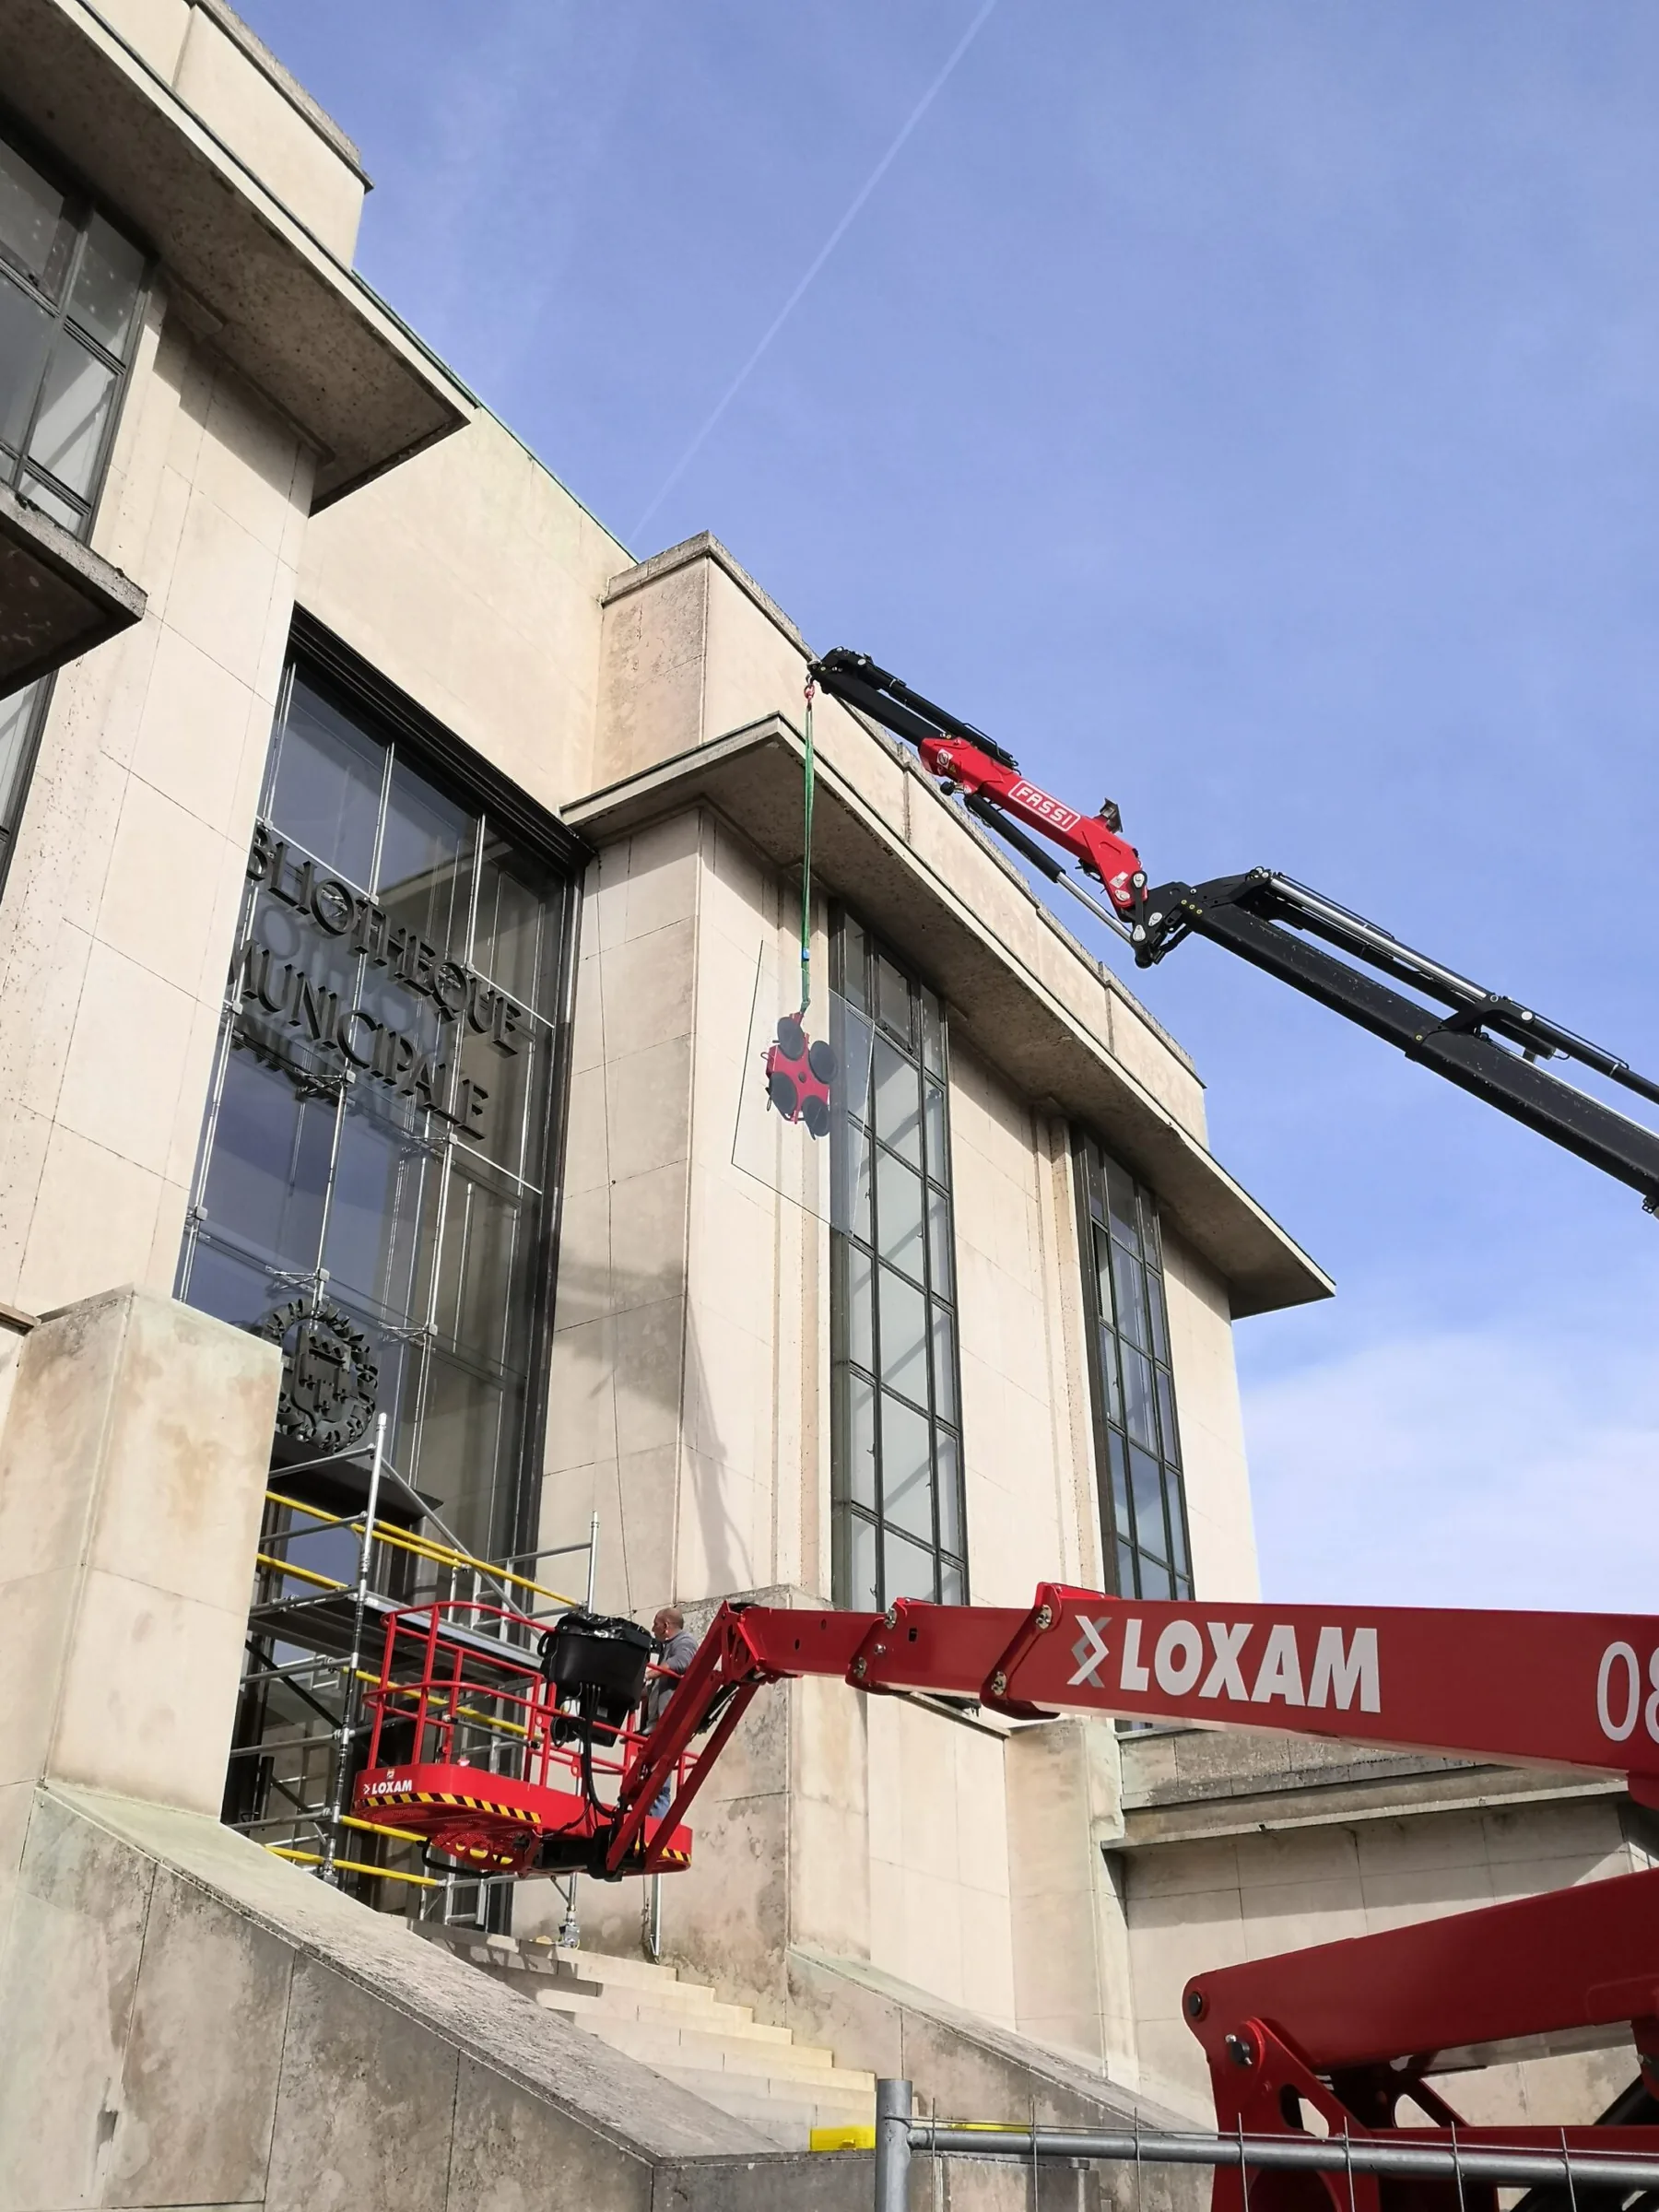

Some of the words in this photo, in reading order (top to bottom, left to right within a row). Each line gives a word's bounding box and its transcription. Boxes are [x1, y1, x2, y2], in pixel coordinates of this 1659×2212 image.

[1016, 786, 1072, 826] FASSI
[1120, 1618, 1381, 1713] LOXAM
[371, 1779, 413, 1794] LOXAM
